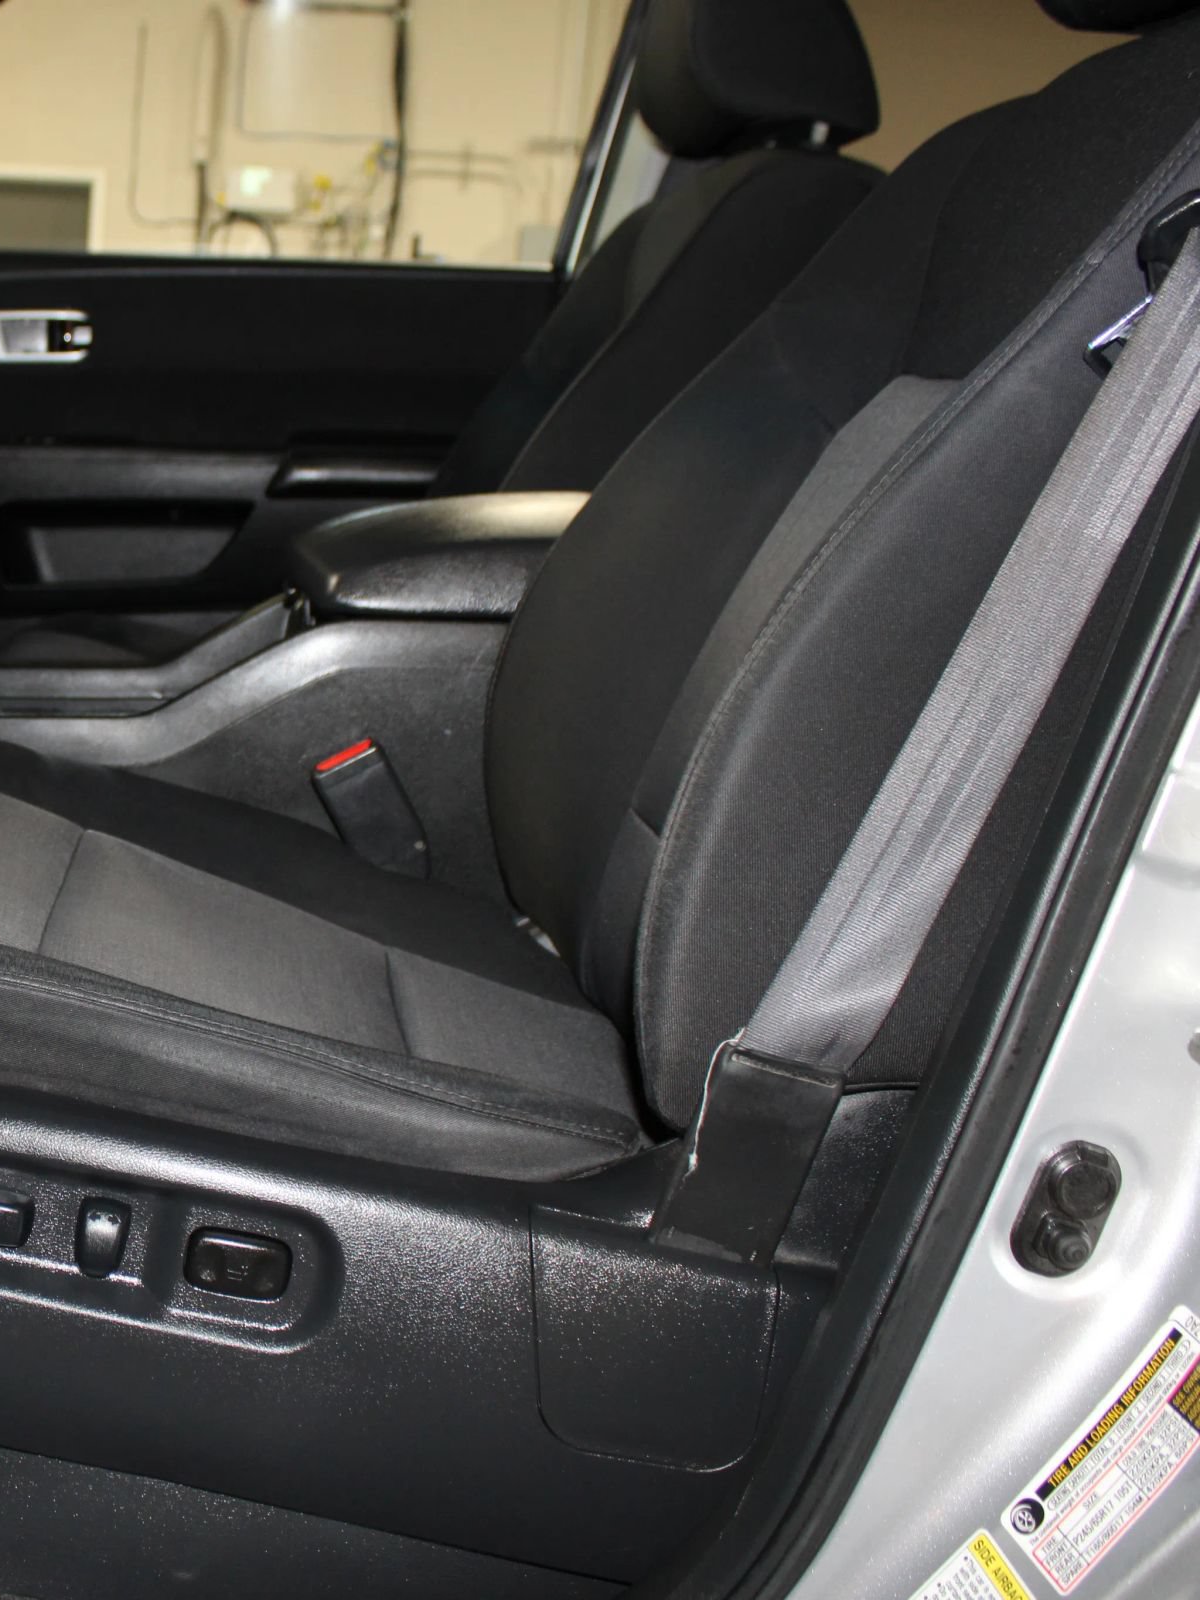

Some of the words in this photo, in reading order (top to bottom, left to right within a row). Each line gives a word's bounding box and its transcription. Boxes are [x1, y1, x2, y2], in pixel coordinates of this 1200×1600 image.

[1047, 1462, 1070, 1489] TIRE
[1066, 1442, 1088, 1468] AND
[1084, 1401, 1124, 1448] LOADING
[1120, 1336, 1175, 1407] INFORMATION
[1112, 1478, 1133, 1502] 105T
[974, 1540, 996, 1567] SIDE
[1041, 1535, 1059, 1555] TIRE
[1044, 1540, 1069, 1568] FRONT
[1054, 1550, 1075, 1575] REAR
[1060, 1558, 1083, 1585] SPARE
